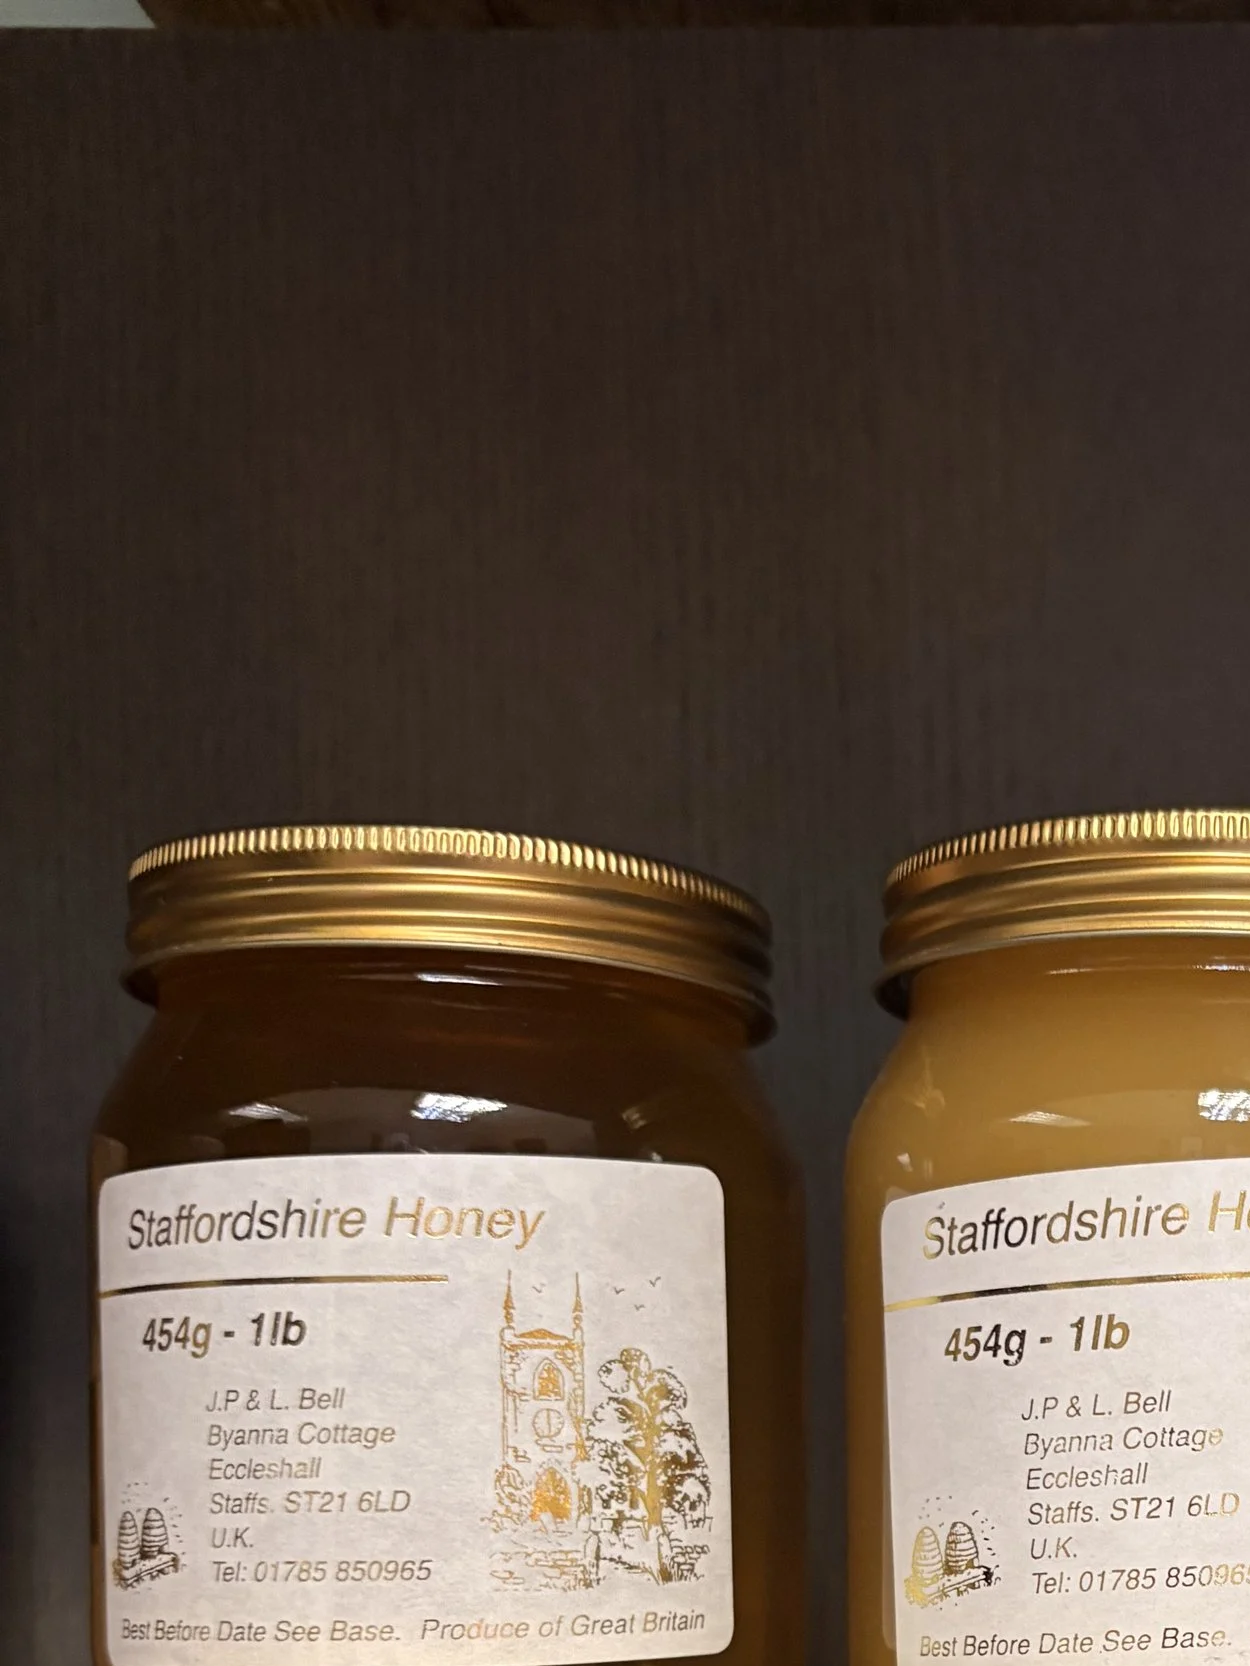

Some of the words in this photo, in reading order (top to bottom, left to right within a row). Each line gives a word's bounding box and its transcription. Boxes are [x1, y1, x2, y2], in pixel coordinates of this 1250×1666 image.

[129, 1197, 367, 1250] Staffordshire
[383, 1196, 545, 1250] Honey
[923, 1197, 1189, 1259] Staffordshire
[143, 1316, 211, 1358] 454g
[252, 1312, 307, 1347] 1lb
[945, 1323, 1026, 1367] 454g
[1070, 1314, 1130, 1351] 1lb
[206, 1390, 241, 1413] J.P
[299, 1388, 344, 1410] Bell
[1022, 1398, 1058, 1422] J.P
[1093, 1394, 1111, 1417] L.
[1124, 1391, 1171, 1414] Bell
[208, 1424, 291, 1447] Byanna
[298, 1423, 396, 1450] Cottage
[1024, 1431, 1112, 1457] Byanna
[1123, 1425, 1223, 1453] Cottage
[209, 1458, 321, 1481] Eccleshall
[1027, 1464, 1147, 1490] Eccleshall
[285, 1492, 349, 1513] ST21
[358, 1491, 410, 1512] 6LD
[1028, 1501, 1099, 1526] Staffs.
[1110, 1497, 1176, 1521] ST21
[1187, 1493, 1239, 1518] 6LD
[211, 1528, 254, 1548] U.K.
[1031, 1537, 1077, 1560] U.K.
[214, 1561, 247, 1583] Tel:
[254, 1561, 326, 1582] 01785
[336, 1559, 432, 1581] 850965
[1033, 1570, 1071, 1594] Tel:
[1079, 1568, 1155, 1593] 01785
[122, 1619, 150, 1641] Best
[154, 1619, 210, 1642] Before
[217, 1621, 266, 1642] Date
[274, 1621, 320, 1642] See
[329, 1620, 400, 1642] Base.
[421, 1618, 529, 1640] Produce
[538, 1615, 564, 1638] of
[571, 1613, 635, 1636] Great
[643, 1610, 705, 1634] Britain
[920, 1636, 957, 1657] Best
[963, 1634, 1030, 1656] Before
[1039, 1632, 1094, 1655] Date
[1102, 1630, 1152, 1653] See
[1161, 1626, 1232, 1651] Base.
